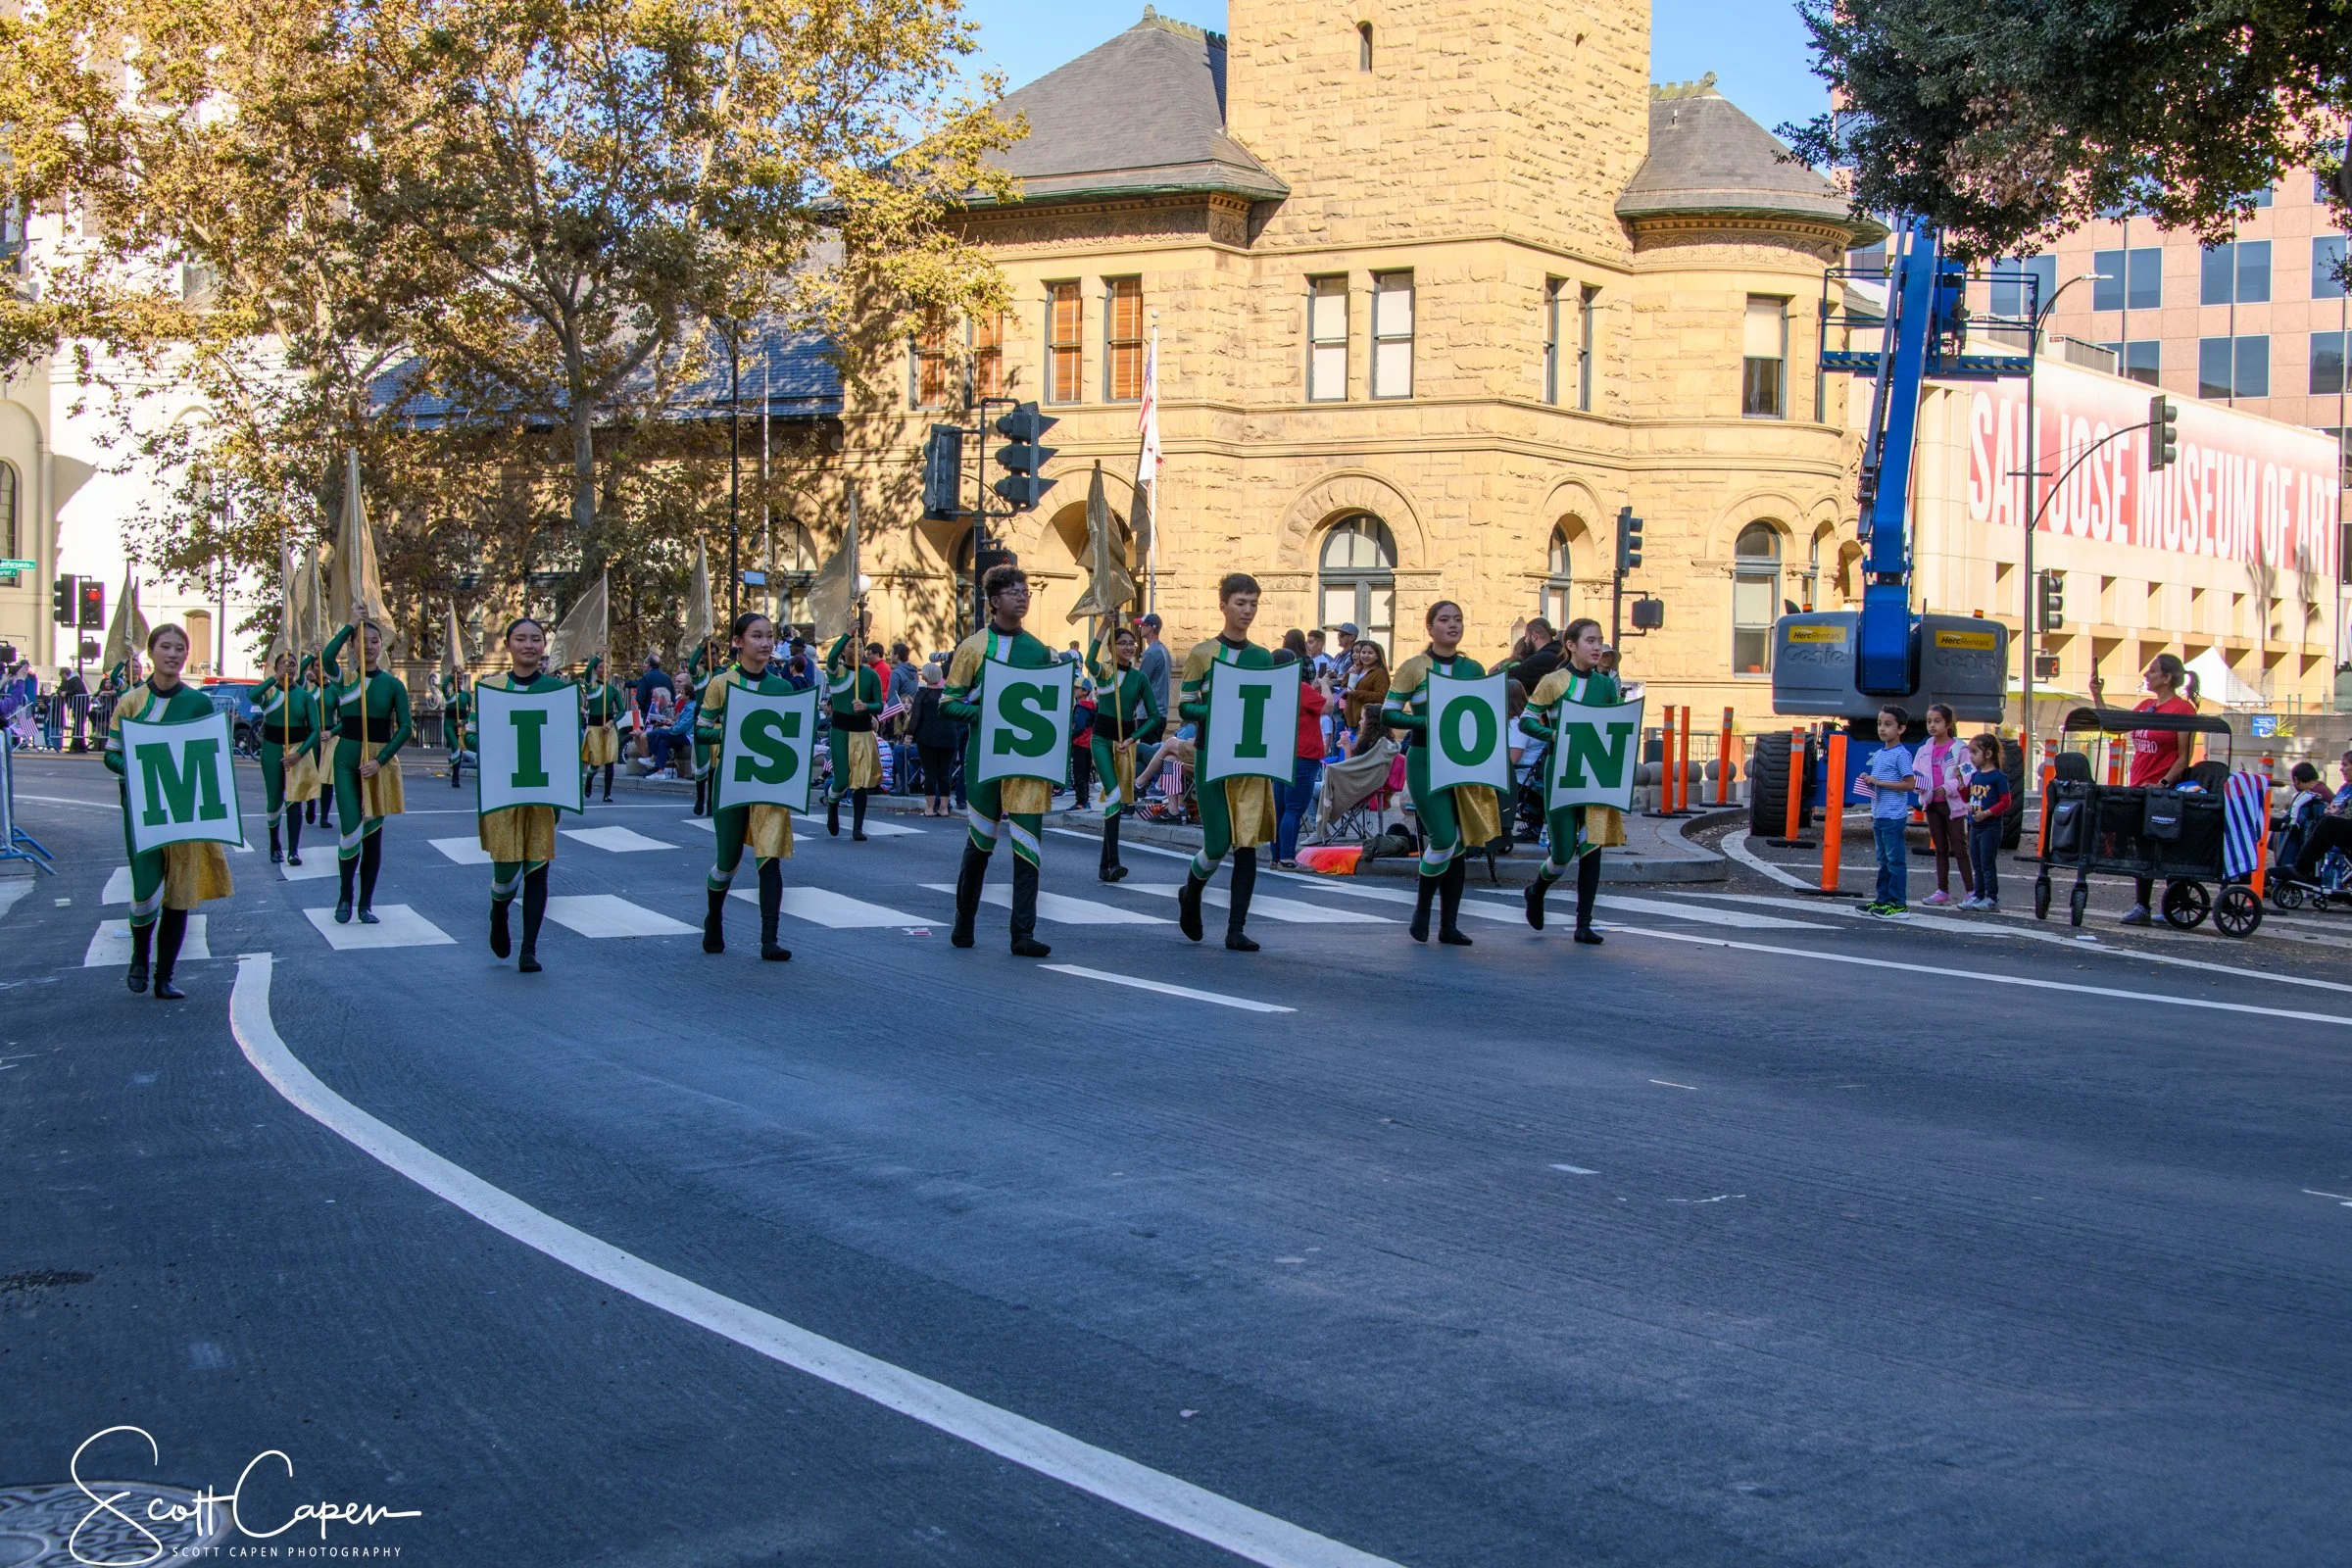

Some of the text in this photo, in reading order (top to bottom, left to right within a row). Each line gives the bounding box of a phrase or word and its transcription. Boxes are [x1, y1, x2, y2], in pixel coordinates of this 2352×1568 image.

[1969, 391, 2338, 577] SAN JOSE MUSEUM OF ART
[1793, 631, 1840, 640] HercRentals
[1940, 636, 1990, 648] HercRentals
[2051, 660, 2058, 674] 2
[135, 682, 1634, 826] M I S S I O N
